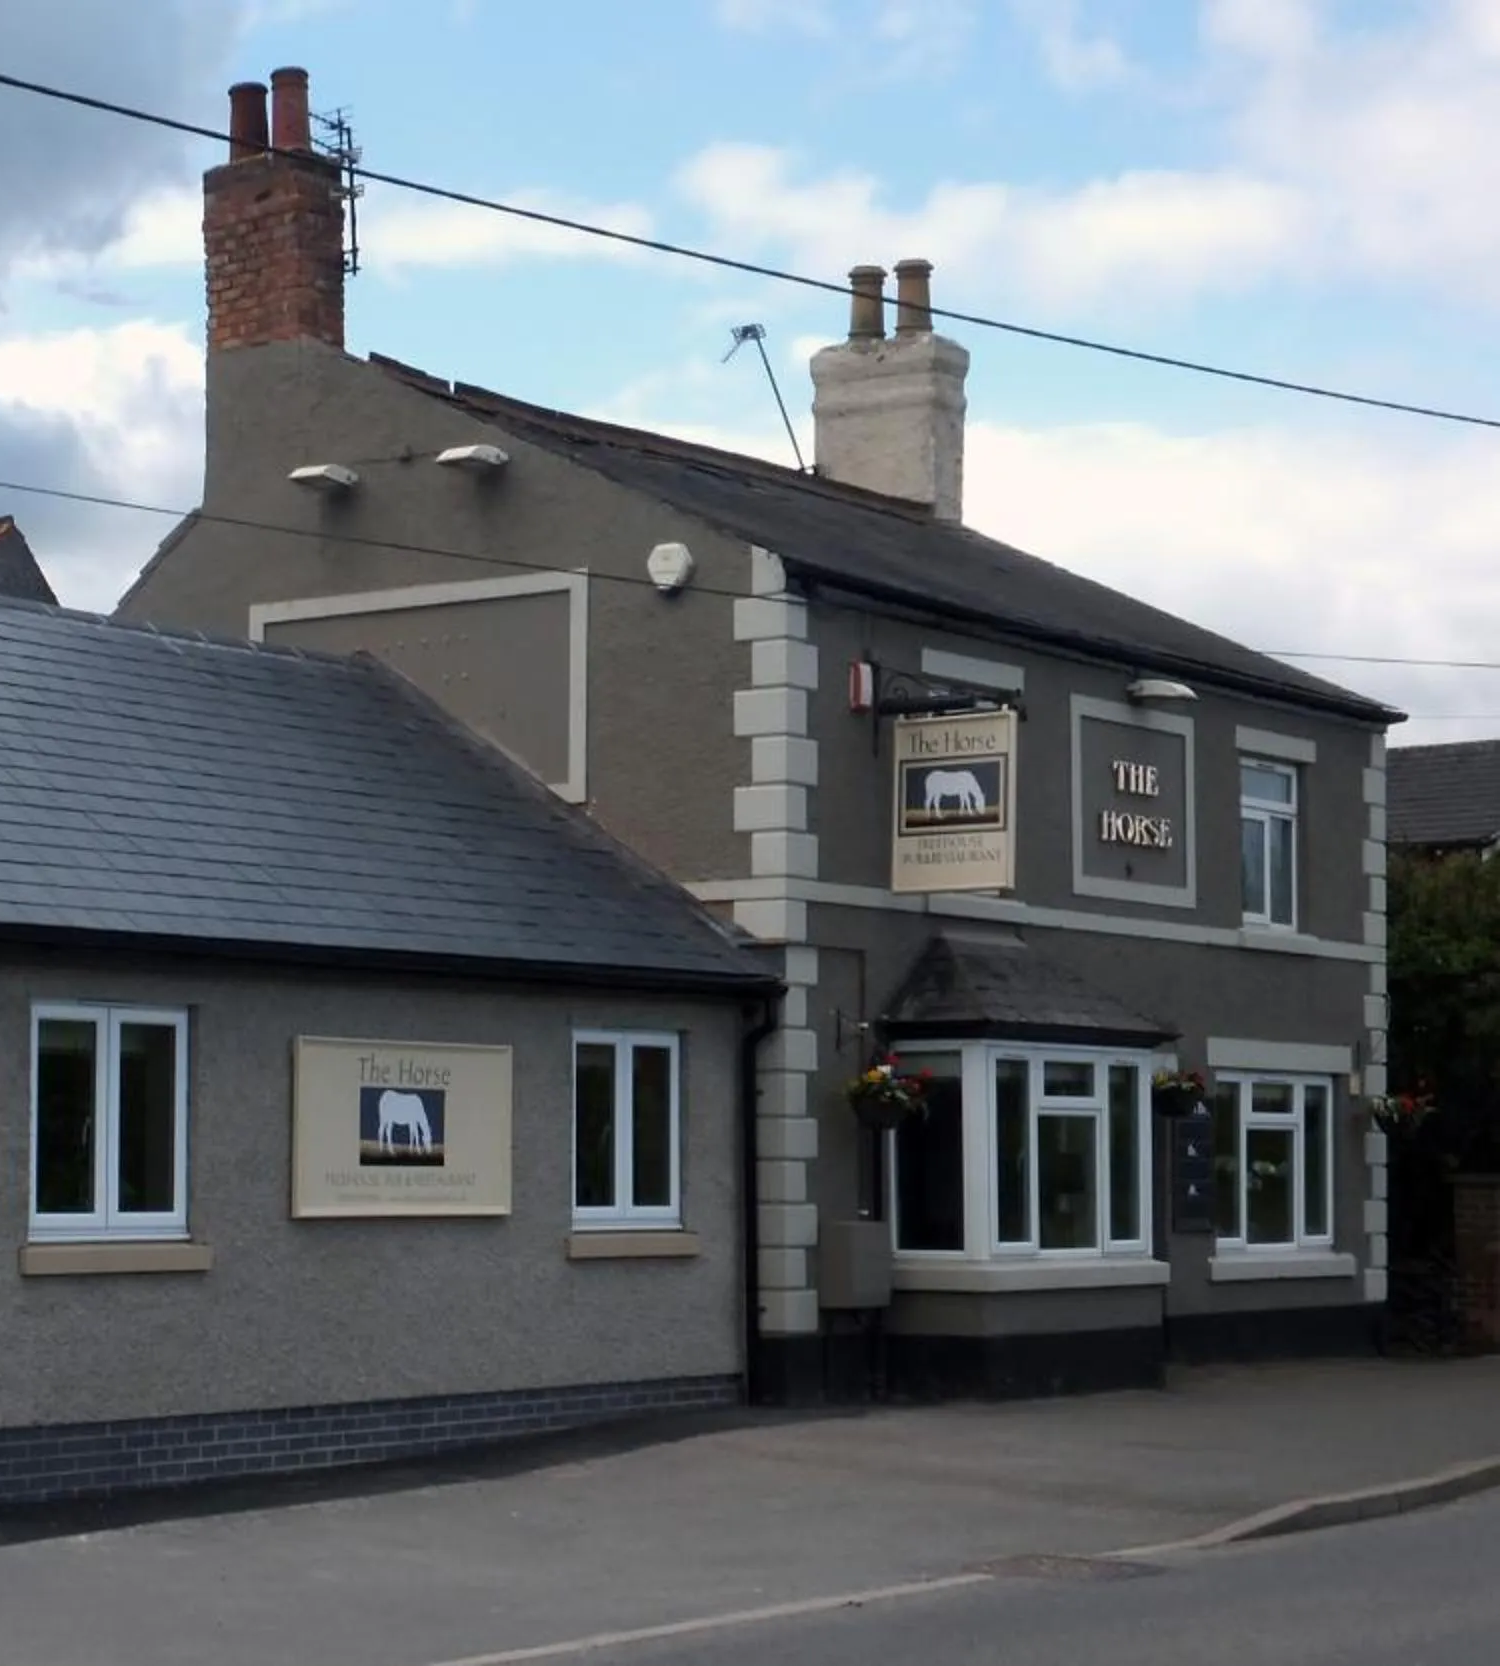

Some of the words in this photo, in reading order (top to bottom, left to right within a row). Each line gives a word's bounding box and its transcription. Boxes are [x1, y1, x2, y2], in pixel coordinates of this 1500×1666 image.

[909, 731, 939, 755] The
[945, 729, 996, 752] Horse
[1112, 759, 1159, 797] THE
[1101, 809, 1173, 848] HORSE
[357, 1053, 390, 1084] The
[399, 1058, 451, 1085] Horse
